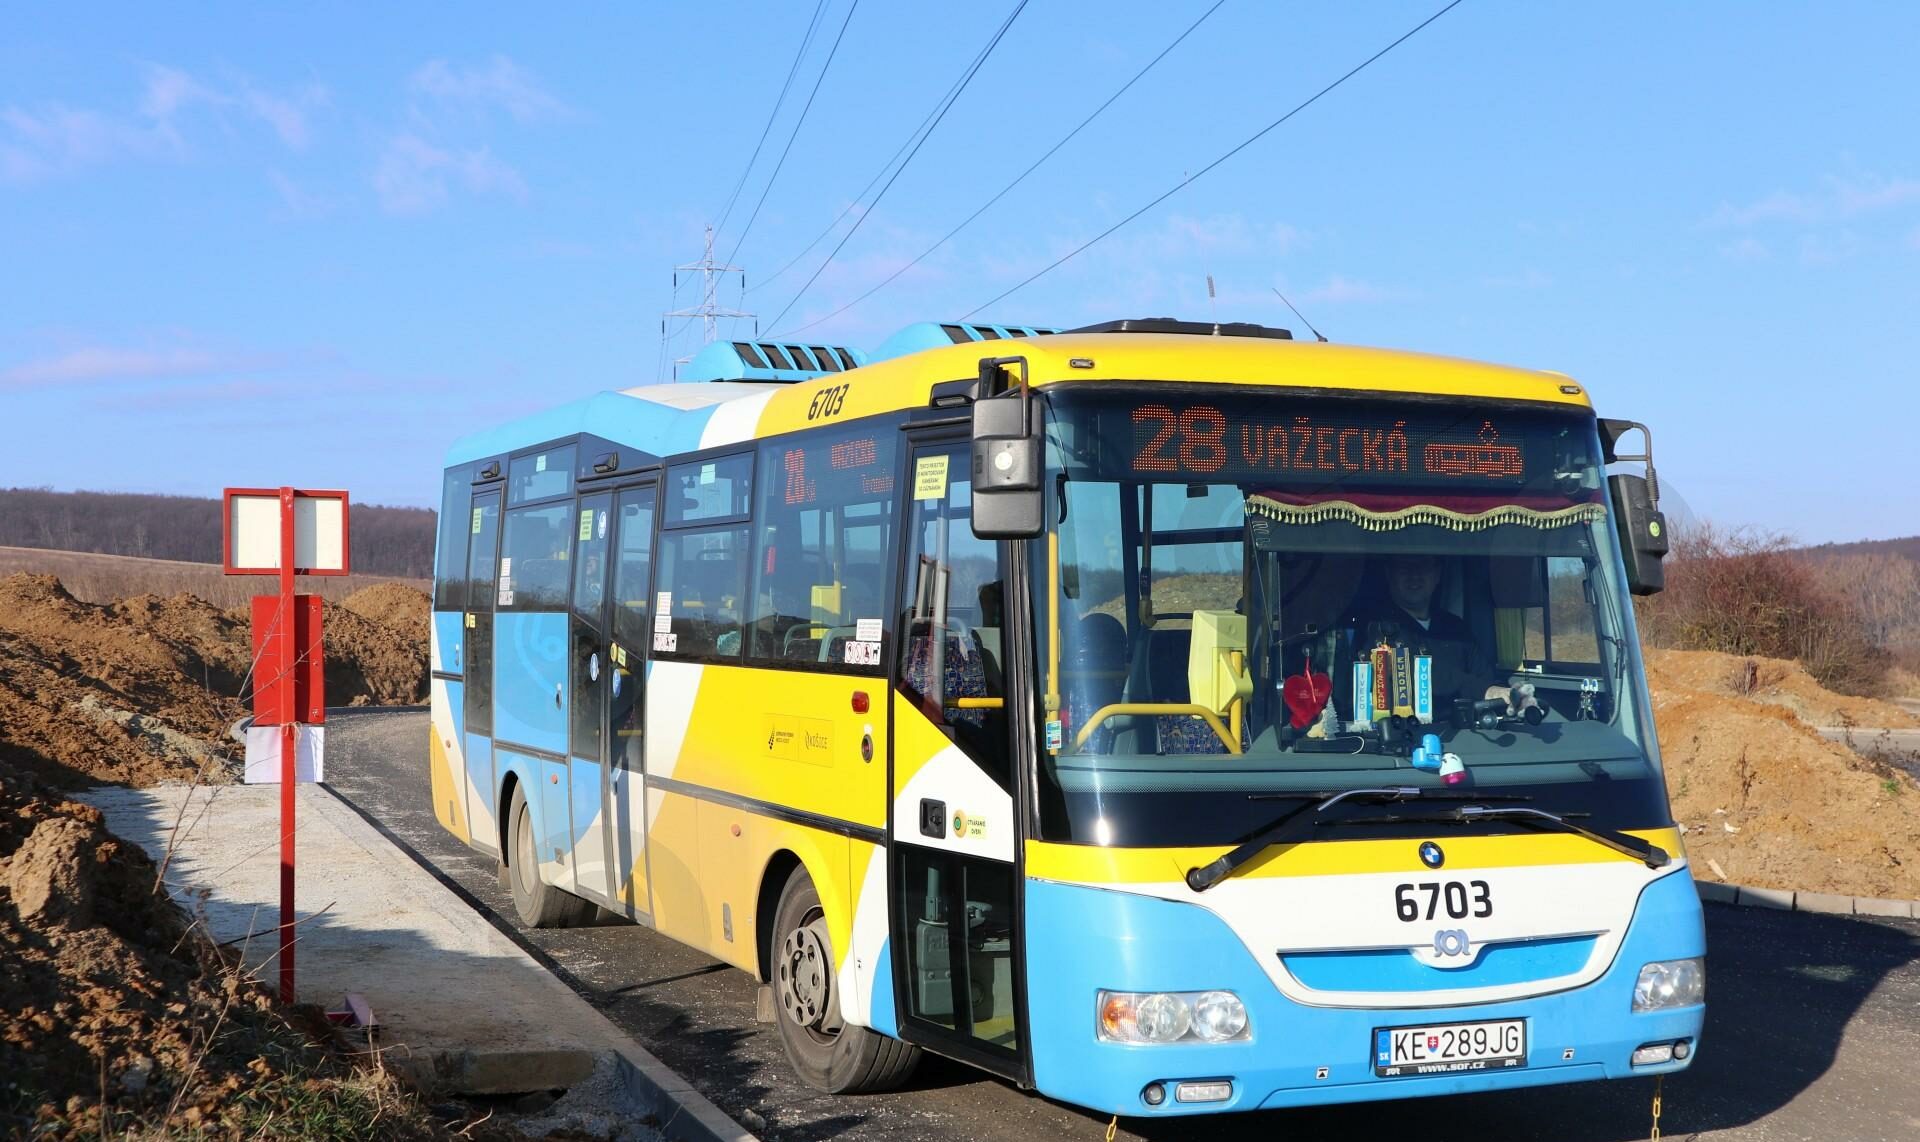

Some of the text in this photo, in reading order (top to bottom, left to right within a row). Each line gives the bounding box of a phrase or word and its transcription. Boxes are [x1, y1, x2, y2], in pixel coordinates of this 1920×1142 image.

[808, 383, 850, 420] 6703
[1132, 404, 1408, 472] 28 VAŽECKÁ
[1397, 657, 1407, 699] EUROPA
[1420, 664, 1429, 705] VOLVO
[1395, 880, 1493, 922] 6703
[1379, 1052, 1389, 1061] SK
[1395, 1025, 1519, 1061] KE 289JG
[1417, 1060, 1486, 1074] www.sor.cz
